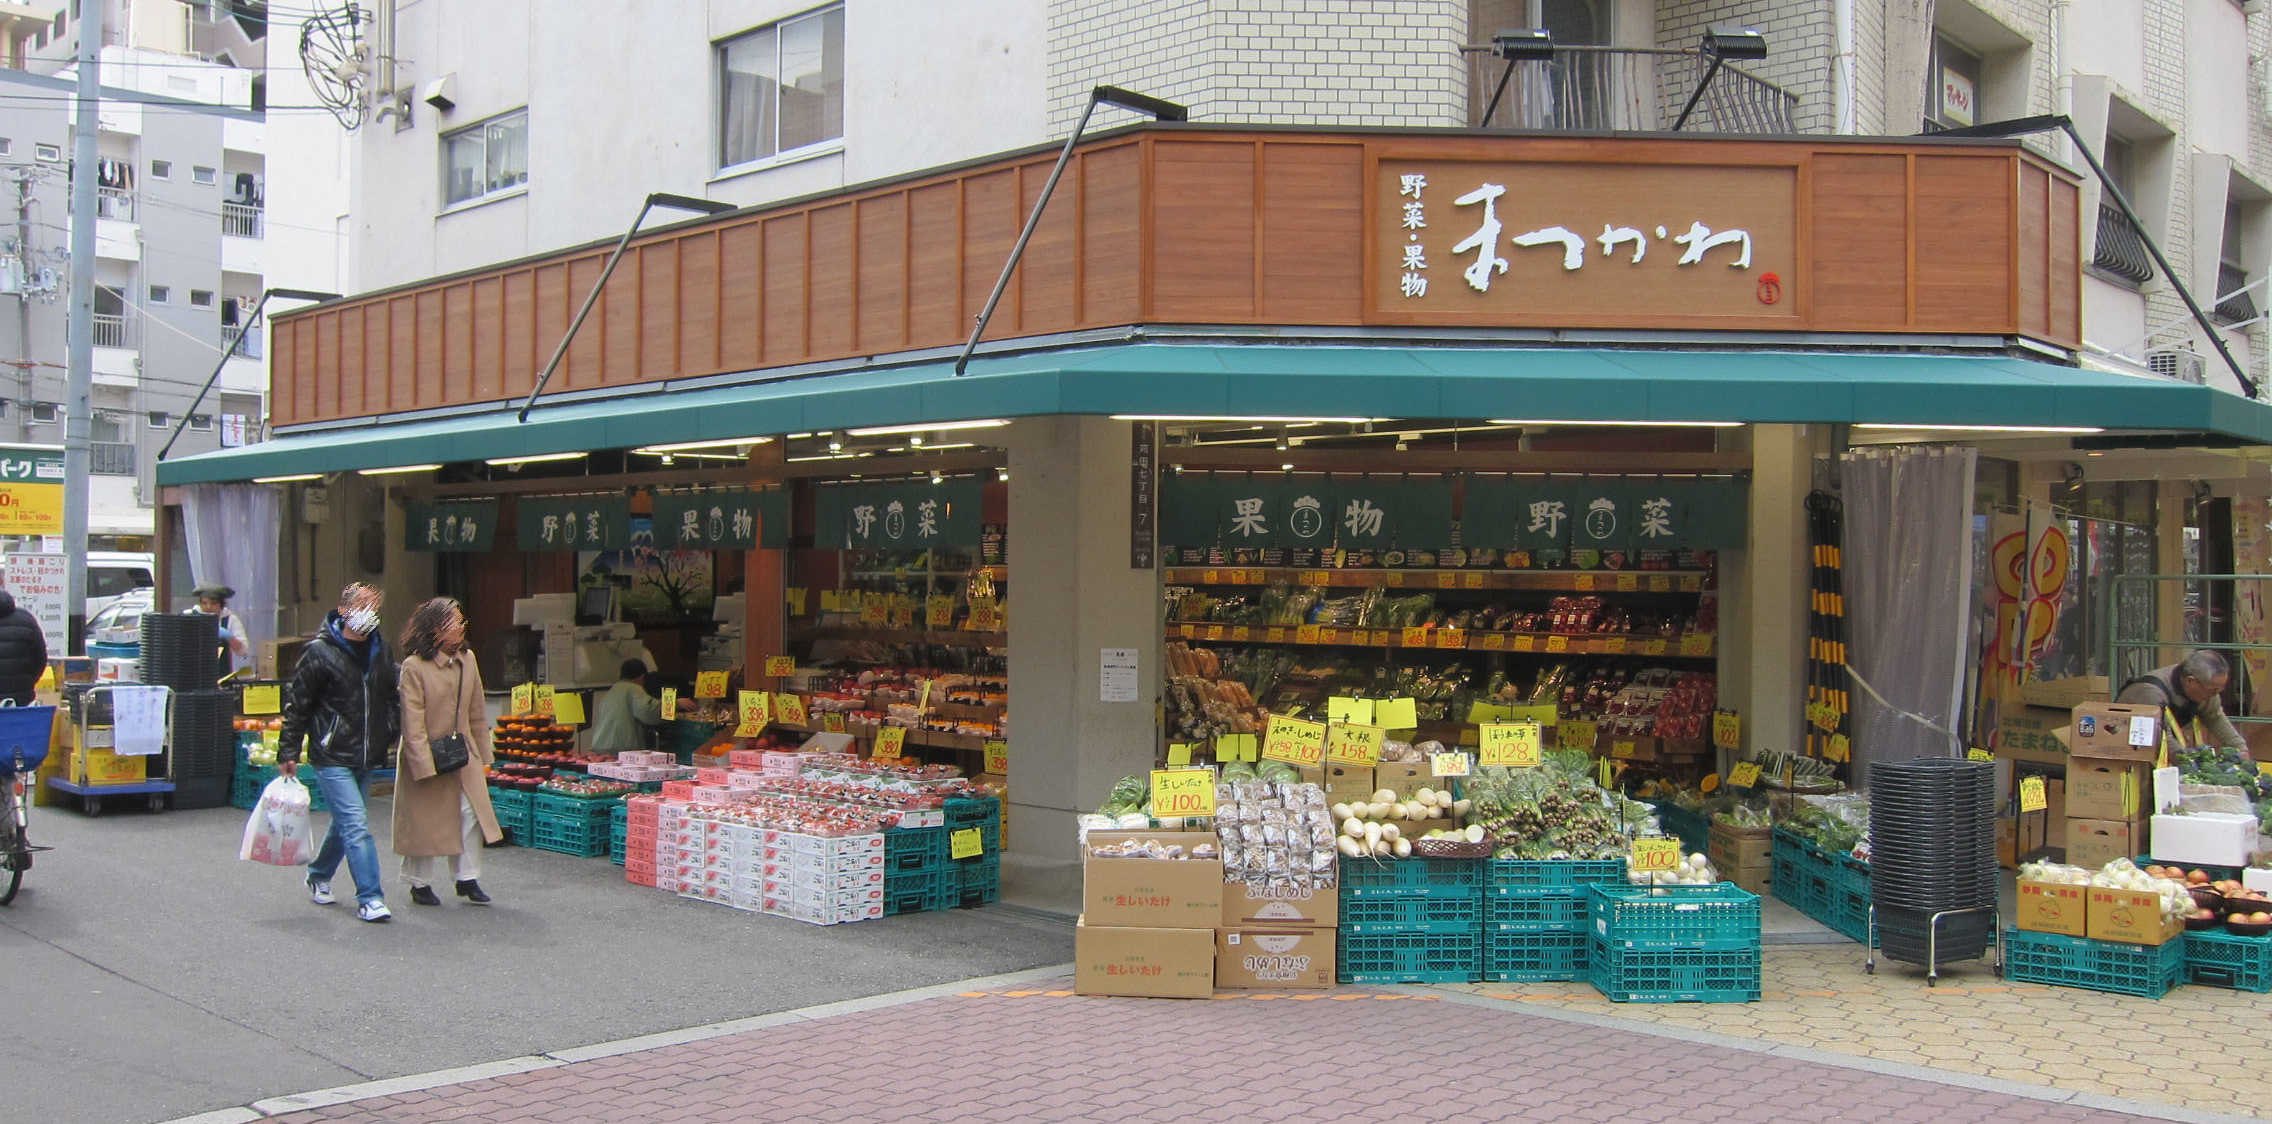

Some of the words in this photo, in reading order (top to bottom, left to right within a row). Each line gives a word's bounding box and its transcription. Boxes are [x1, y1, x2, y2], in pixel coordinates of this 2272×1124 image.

[1399, 174, 1428, 299] 野菜・果物
[1452, 182, 1752, 293] まつかわ
[1344, 729, 1371, 743] 大根
[1246, 884, 1312, 899] ぶなしめじ
[1115, 895, 1172, 907] 生しいたけ
[1107, 963, 1163, 976] 生しいたけ
[1244, 956, 1309, 970] ぶなしめじ
